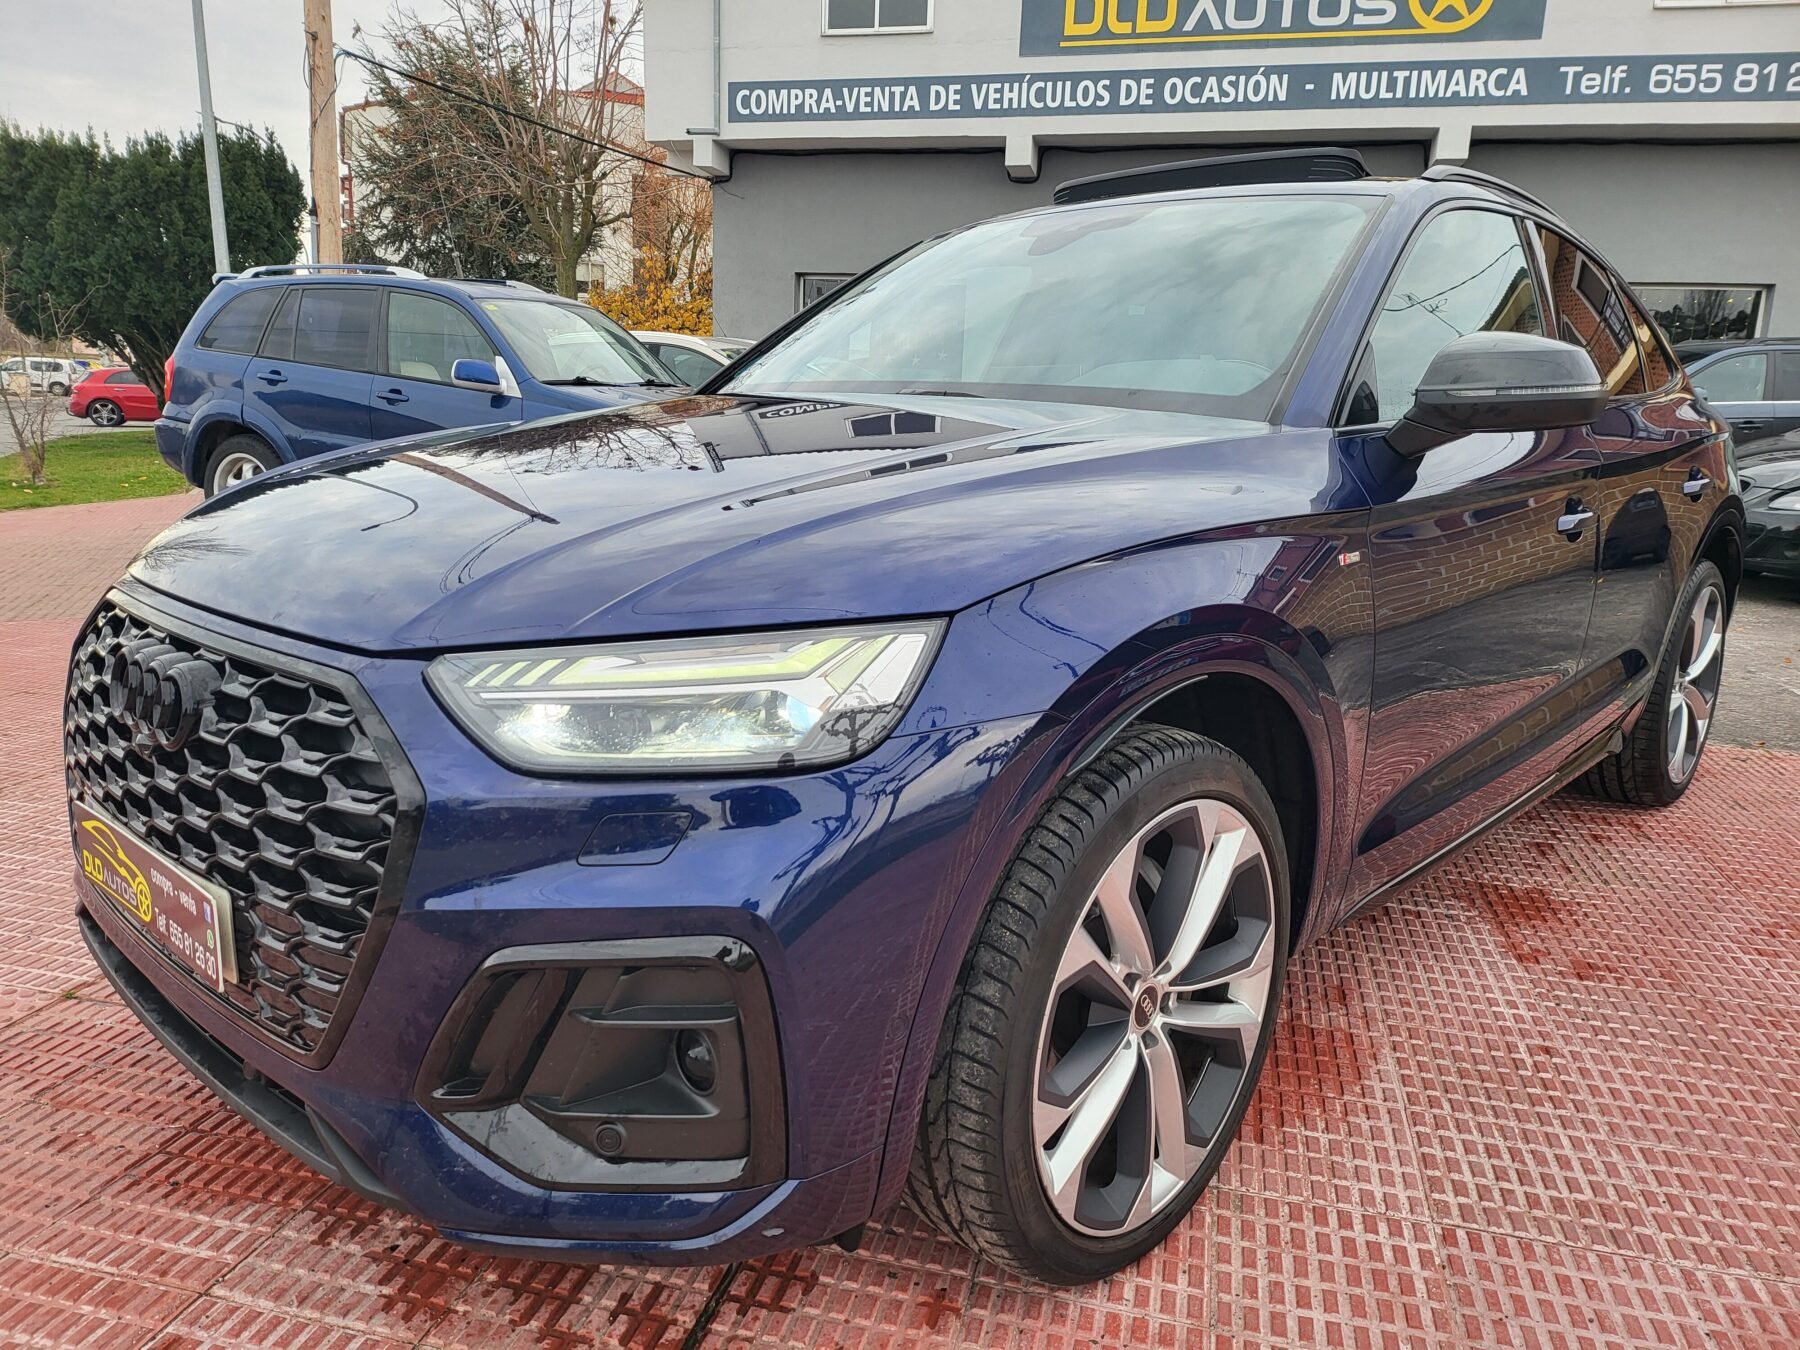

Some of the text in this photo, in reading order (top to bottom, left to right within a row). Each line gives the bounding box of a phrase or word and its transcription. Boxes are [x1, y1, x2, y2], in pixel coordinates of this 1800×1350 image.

[735, 85, 920, 115] COMPRA-VENTA
[929, 84, 961, 111] DE
[971, 75, 1110, 110] VEHÍCULOS
[1119, 78, 1154, 106] DE
[1163, 67, 1289, 105] OCASIÓN
[1330, 67, 1528, 100] MULTIMARCA
[1559, 65, 1631, 95] Telf.
[1648, 63, 1724, 94] 655
[150, 867, 174, 898] compra
[178, 889, 197, 917] venta
[169, 919, 184, 950] 655
[184, 932, 194, 959] 81
[195, 941, 206, 970] 26
[206, 951, 217, 980] 30
